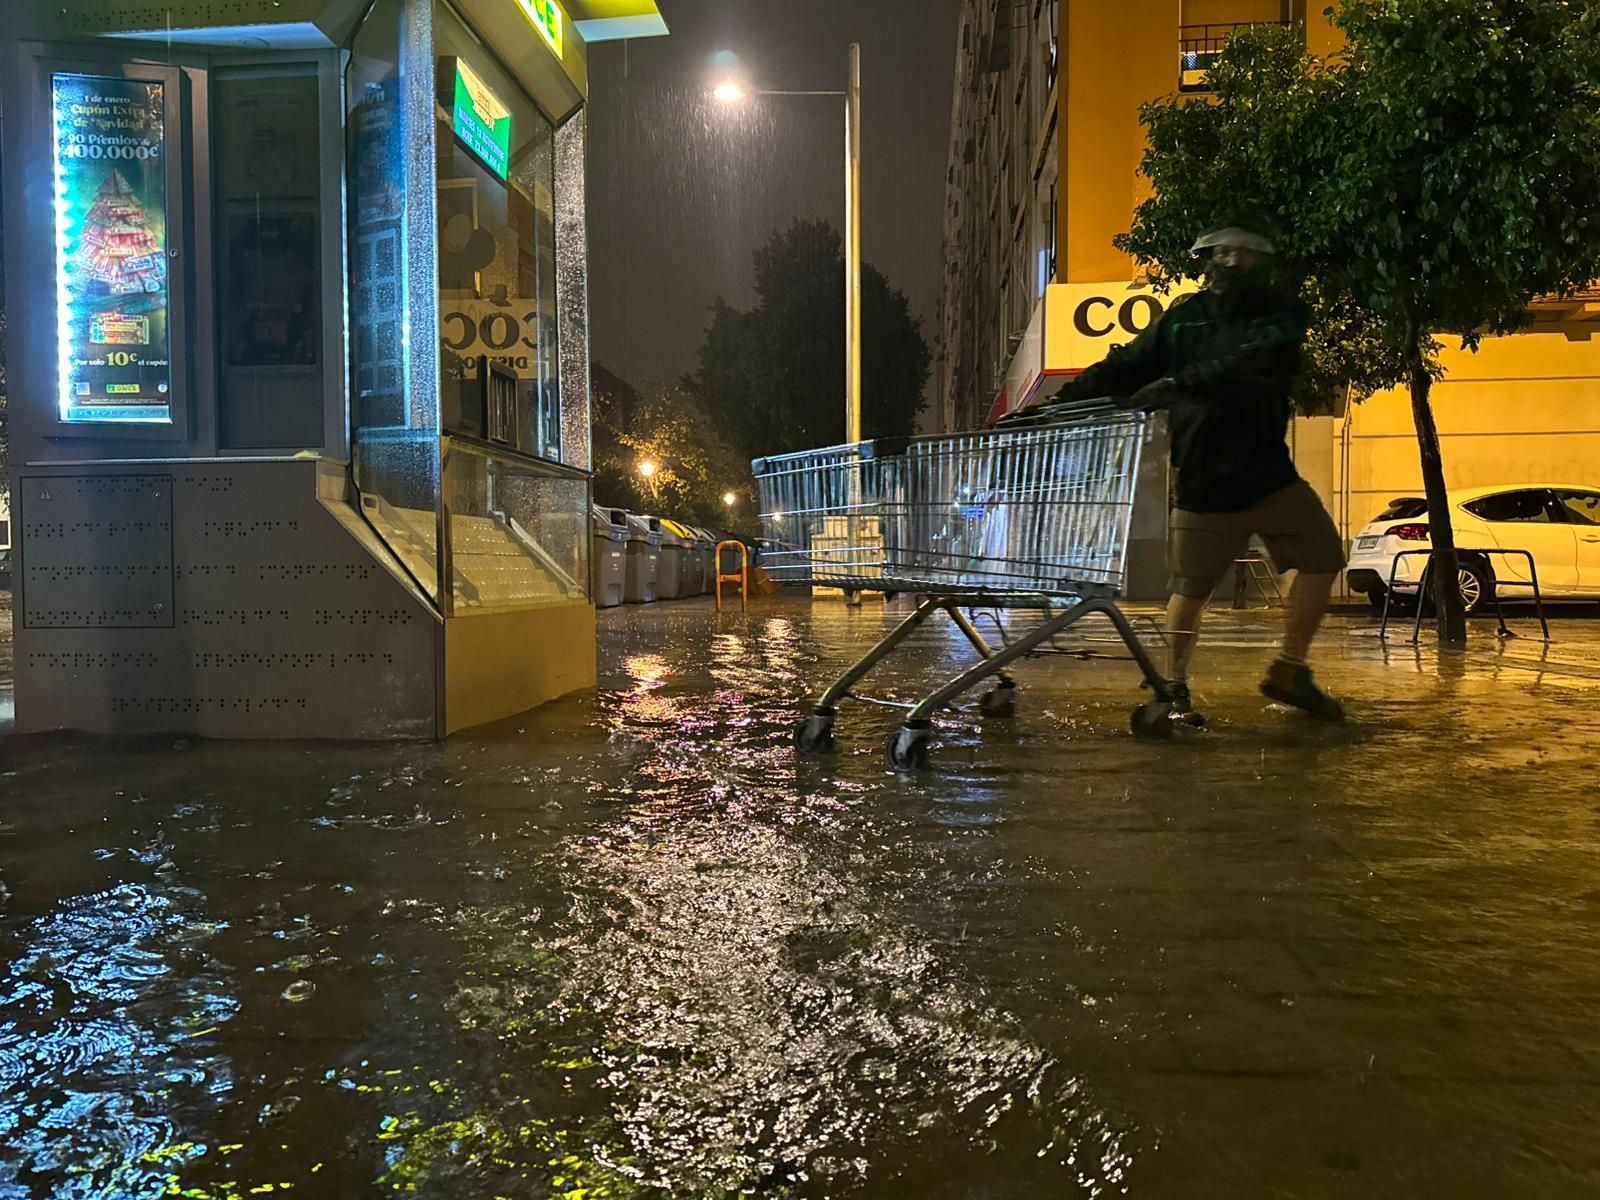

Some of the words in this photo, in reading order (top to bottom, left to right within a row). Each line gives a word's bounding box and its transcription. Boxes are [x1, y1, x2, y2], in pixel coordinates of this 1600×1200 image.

[90, 94, 103, 103] de
[104, 96, 131, 104] enero
[70, 103, 111, 116] Cupón
[113, 105, 146, 118] Extra
[88, 133, 139, 146] Premios
[74, 358, 88, 366] Por
[89, 358, 106, 366] solo
